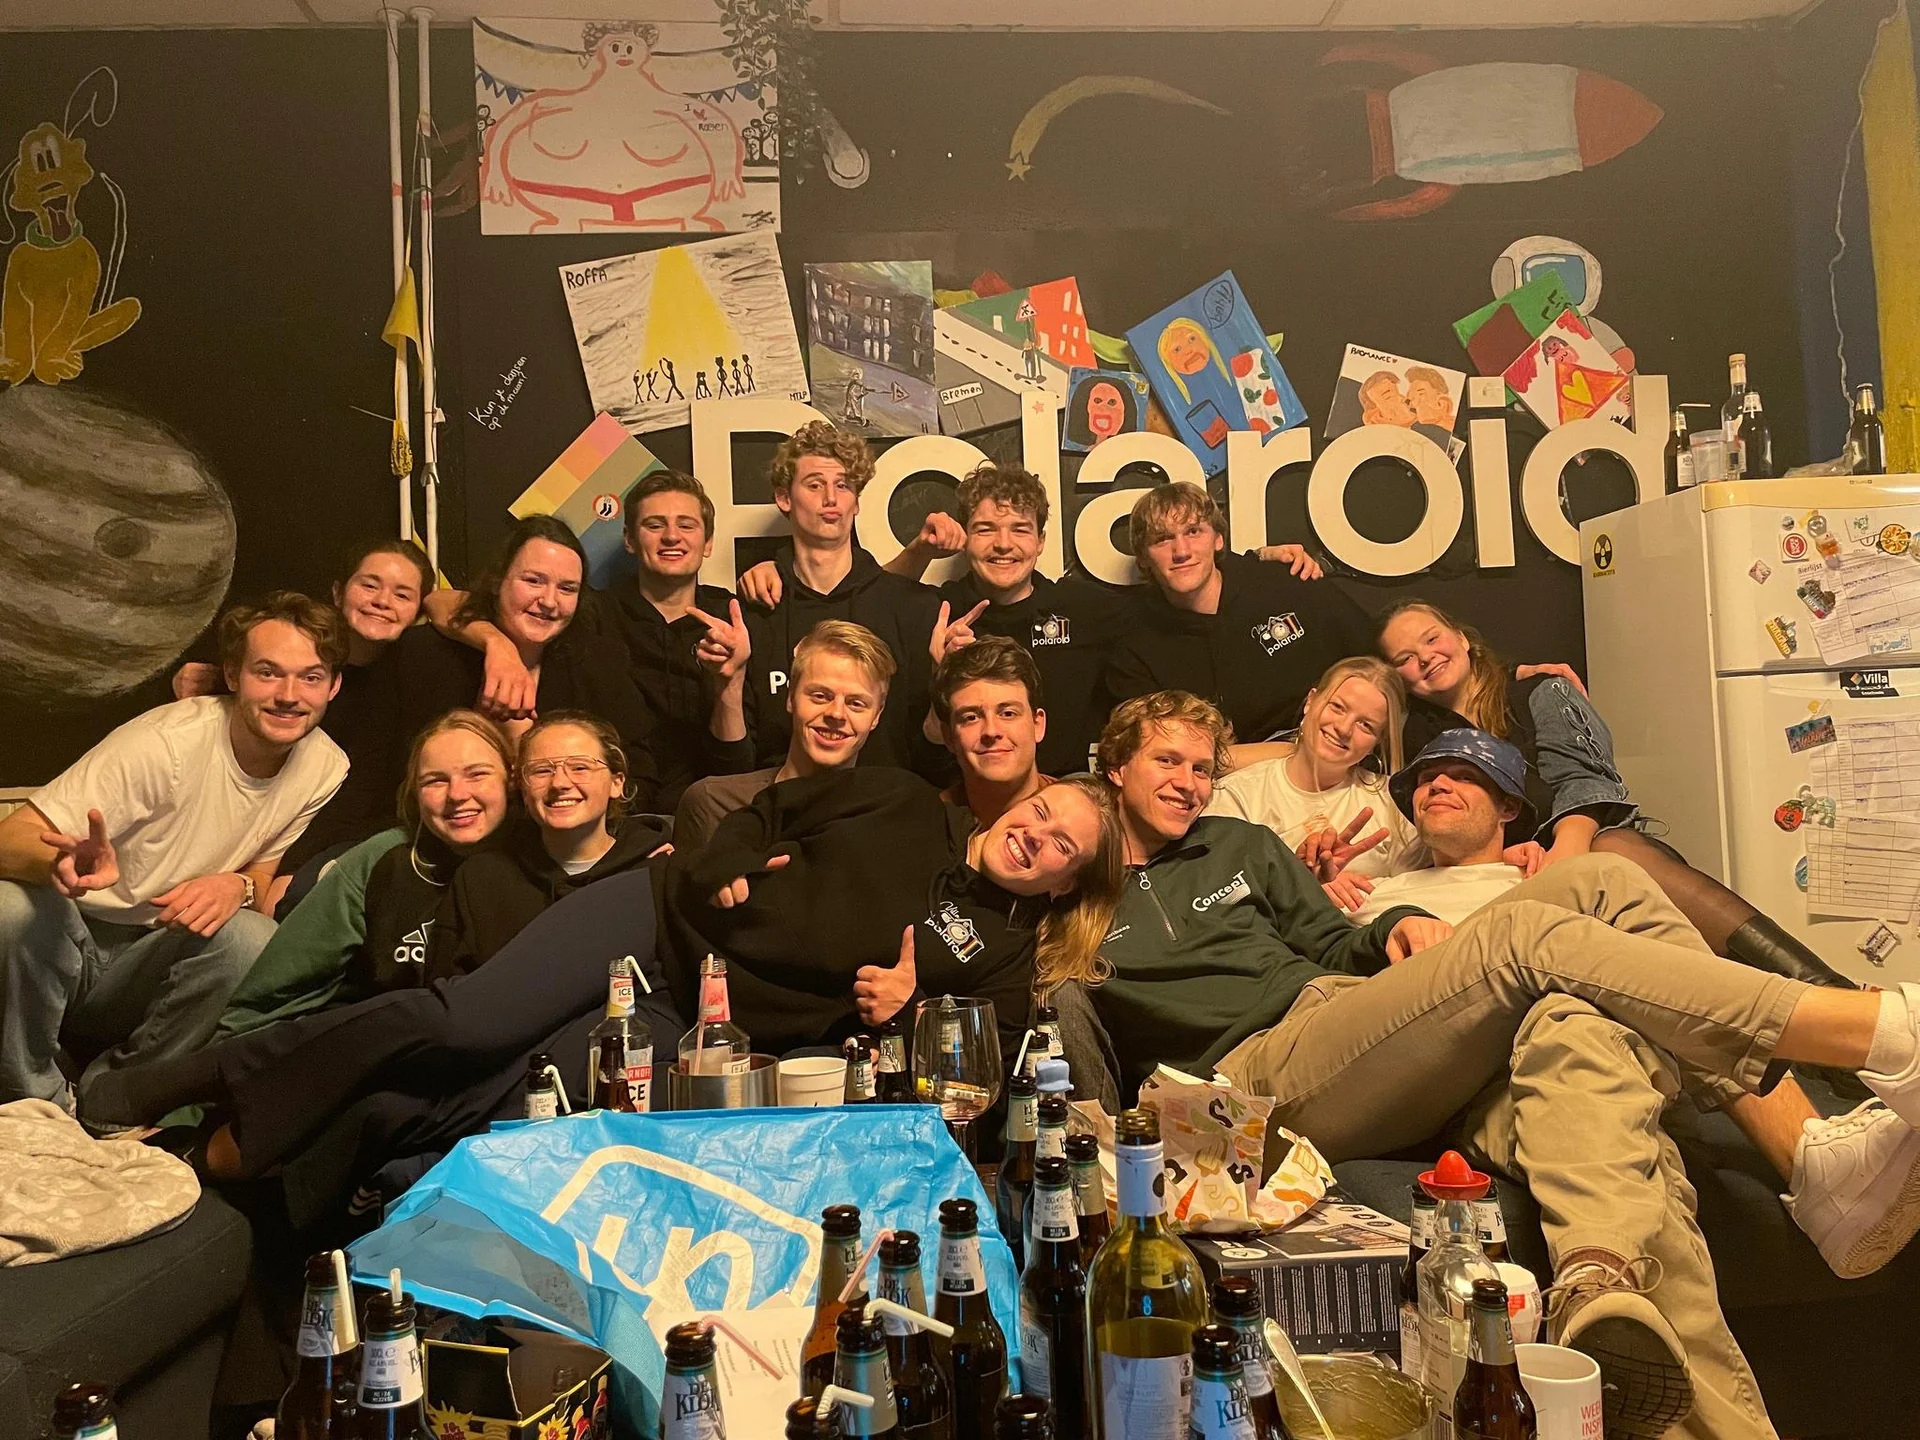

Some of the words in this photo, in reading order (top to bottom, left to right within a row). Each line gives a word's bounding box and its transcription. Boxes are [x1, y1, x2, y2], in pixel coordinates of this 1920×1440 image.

[565, 267, 608, 290] ROFFA
[941, 386, 982, 402] Bremen
[467, 401, 497, 426] Kun
[488, 416, 502, 430] op
[689, 375, 1669, 590] Polaroid
[1032, 633, 1071, 648] polaroid
[1267, 626, 1305, 657] polaroid
[769, 670, 790, 694] P
[1863, 672, 1888, 684] Villa
[618, 988, 632, 996] ICE
[628, 1068, 652, 1079] RNOFF
[628, 1084, 646, 1101] CE
[689, 1380, 713, 1396] DE
[1216, 1398, 1250, 1429] KLO
[1580, 1399, 1601, 1420] WEE
